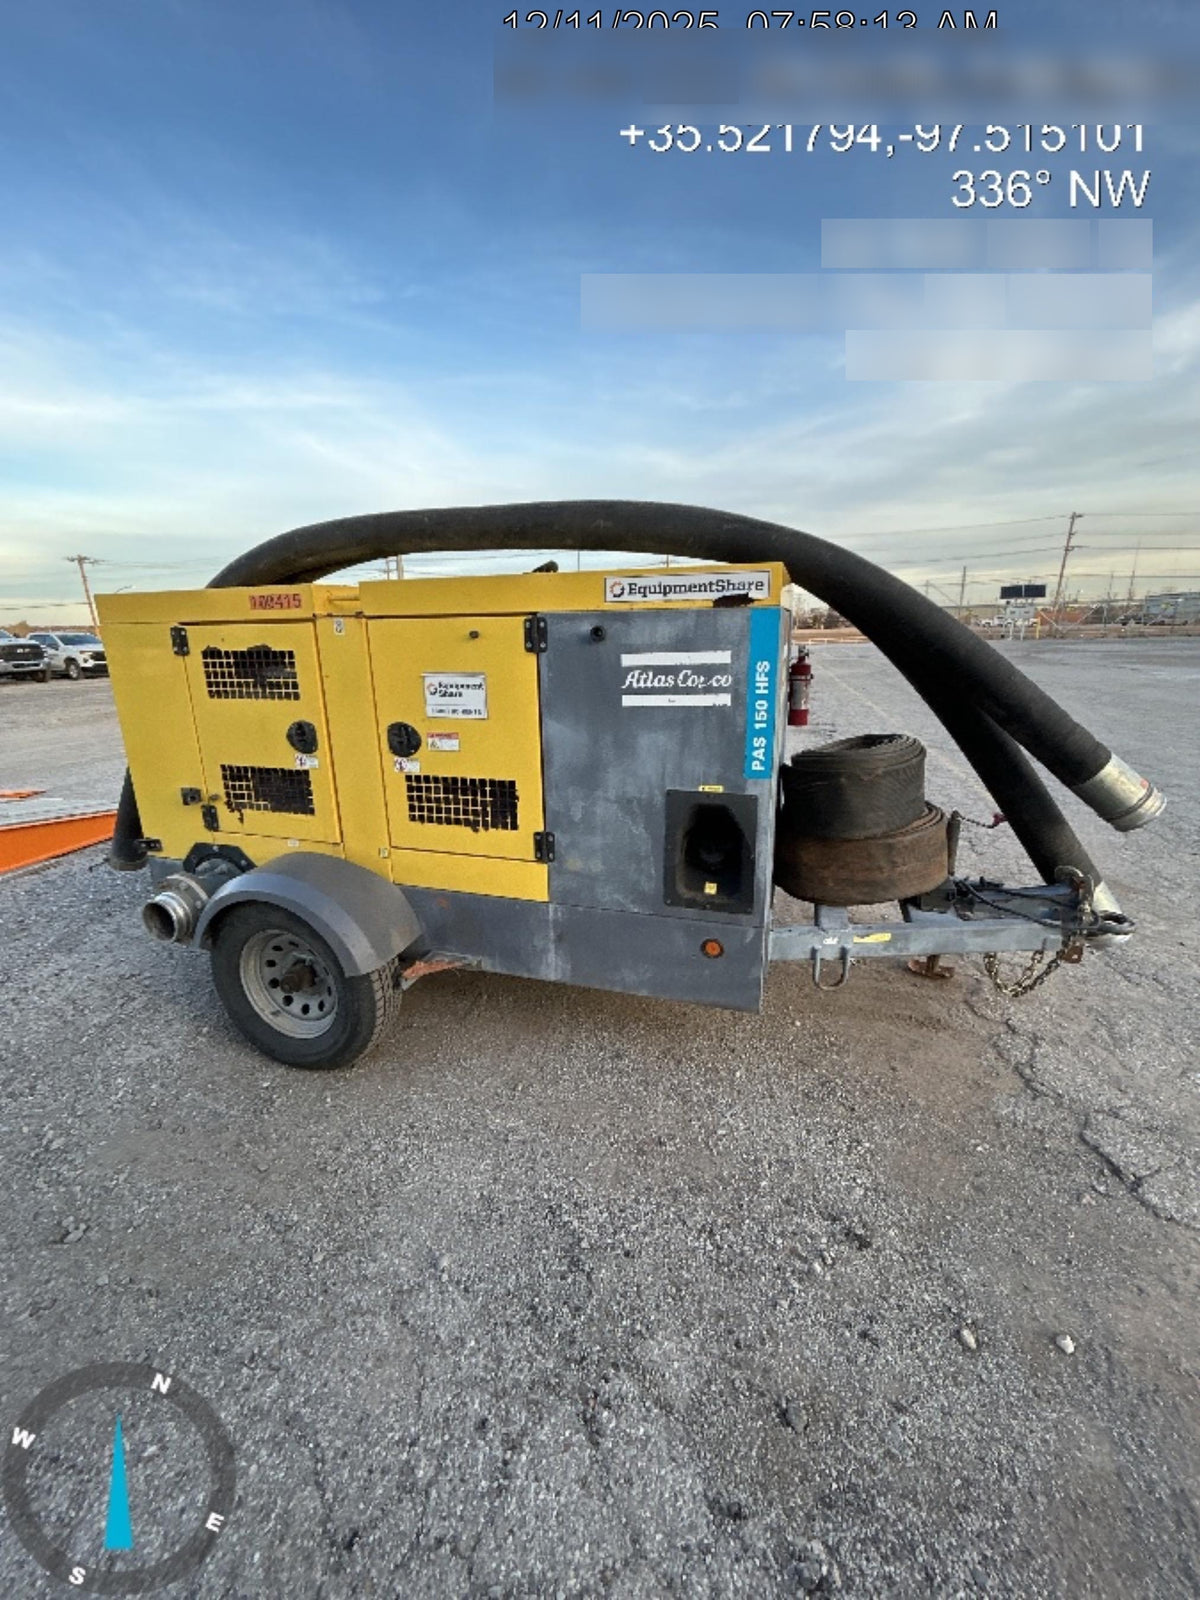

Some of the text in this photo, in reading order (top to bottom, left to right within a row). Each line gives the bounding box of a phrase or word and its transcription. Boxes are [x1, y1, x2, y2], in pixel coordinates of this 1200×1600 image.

[627, 579, 764, 597] EquipmentShare
[621, 669, 675, 689] Atlas
[751, 660, 771, 771] PAS 150 HFS
